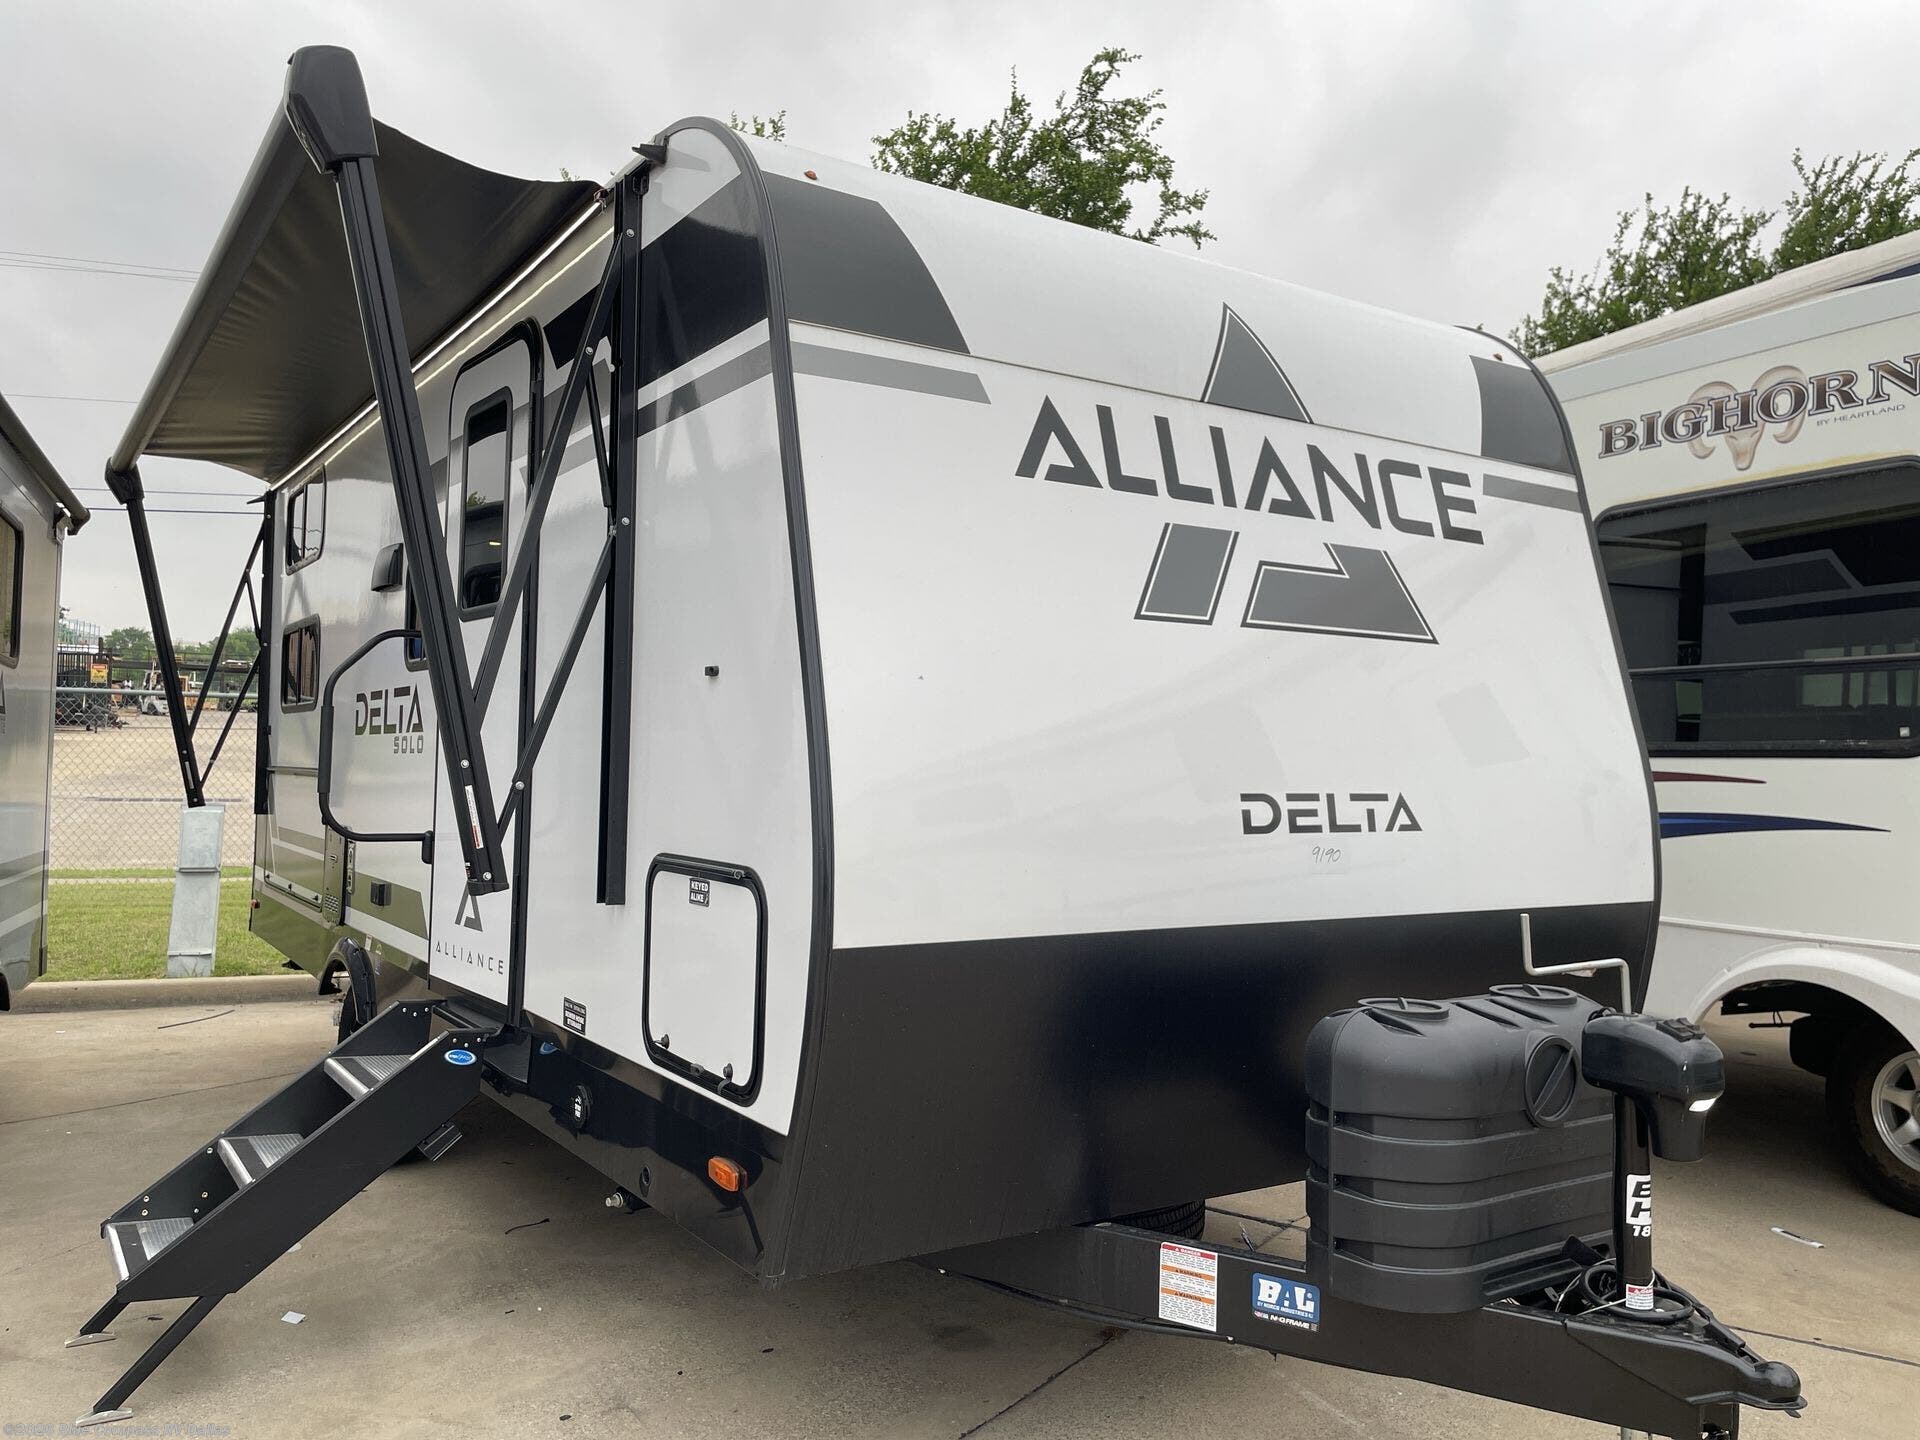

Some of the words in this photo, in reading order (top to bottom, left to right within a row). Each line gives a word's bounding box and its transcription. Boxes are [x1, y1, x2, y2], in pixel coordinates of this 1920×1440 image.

[1598, 353, 1920, 459] BIGHORN
[1816, 418, 1830, 426] BY
[1834, 404, 1905, 424] HEARTLAND
[1015, 394, 1485, 545] ALLIANCE
[355, 684, 424, 735] DELTA
[393, 734, 424, 754] SOLO
[1240, 792, 1423, 834] DELTA
[1312, 845, 1342, 863] 9190
[691, 881, 708, 892] KEYED
[435, 940, 504, 975] ALLIANCE
[1257, 1278, 1315, 1313] BAL
